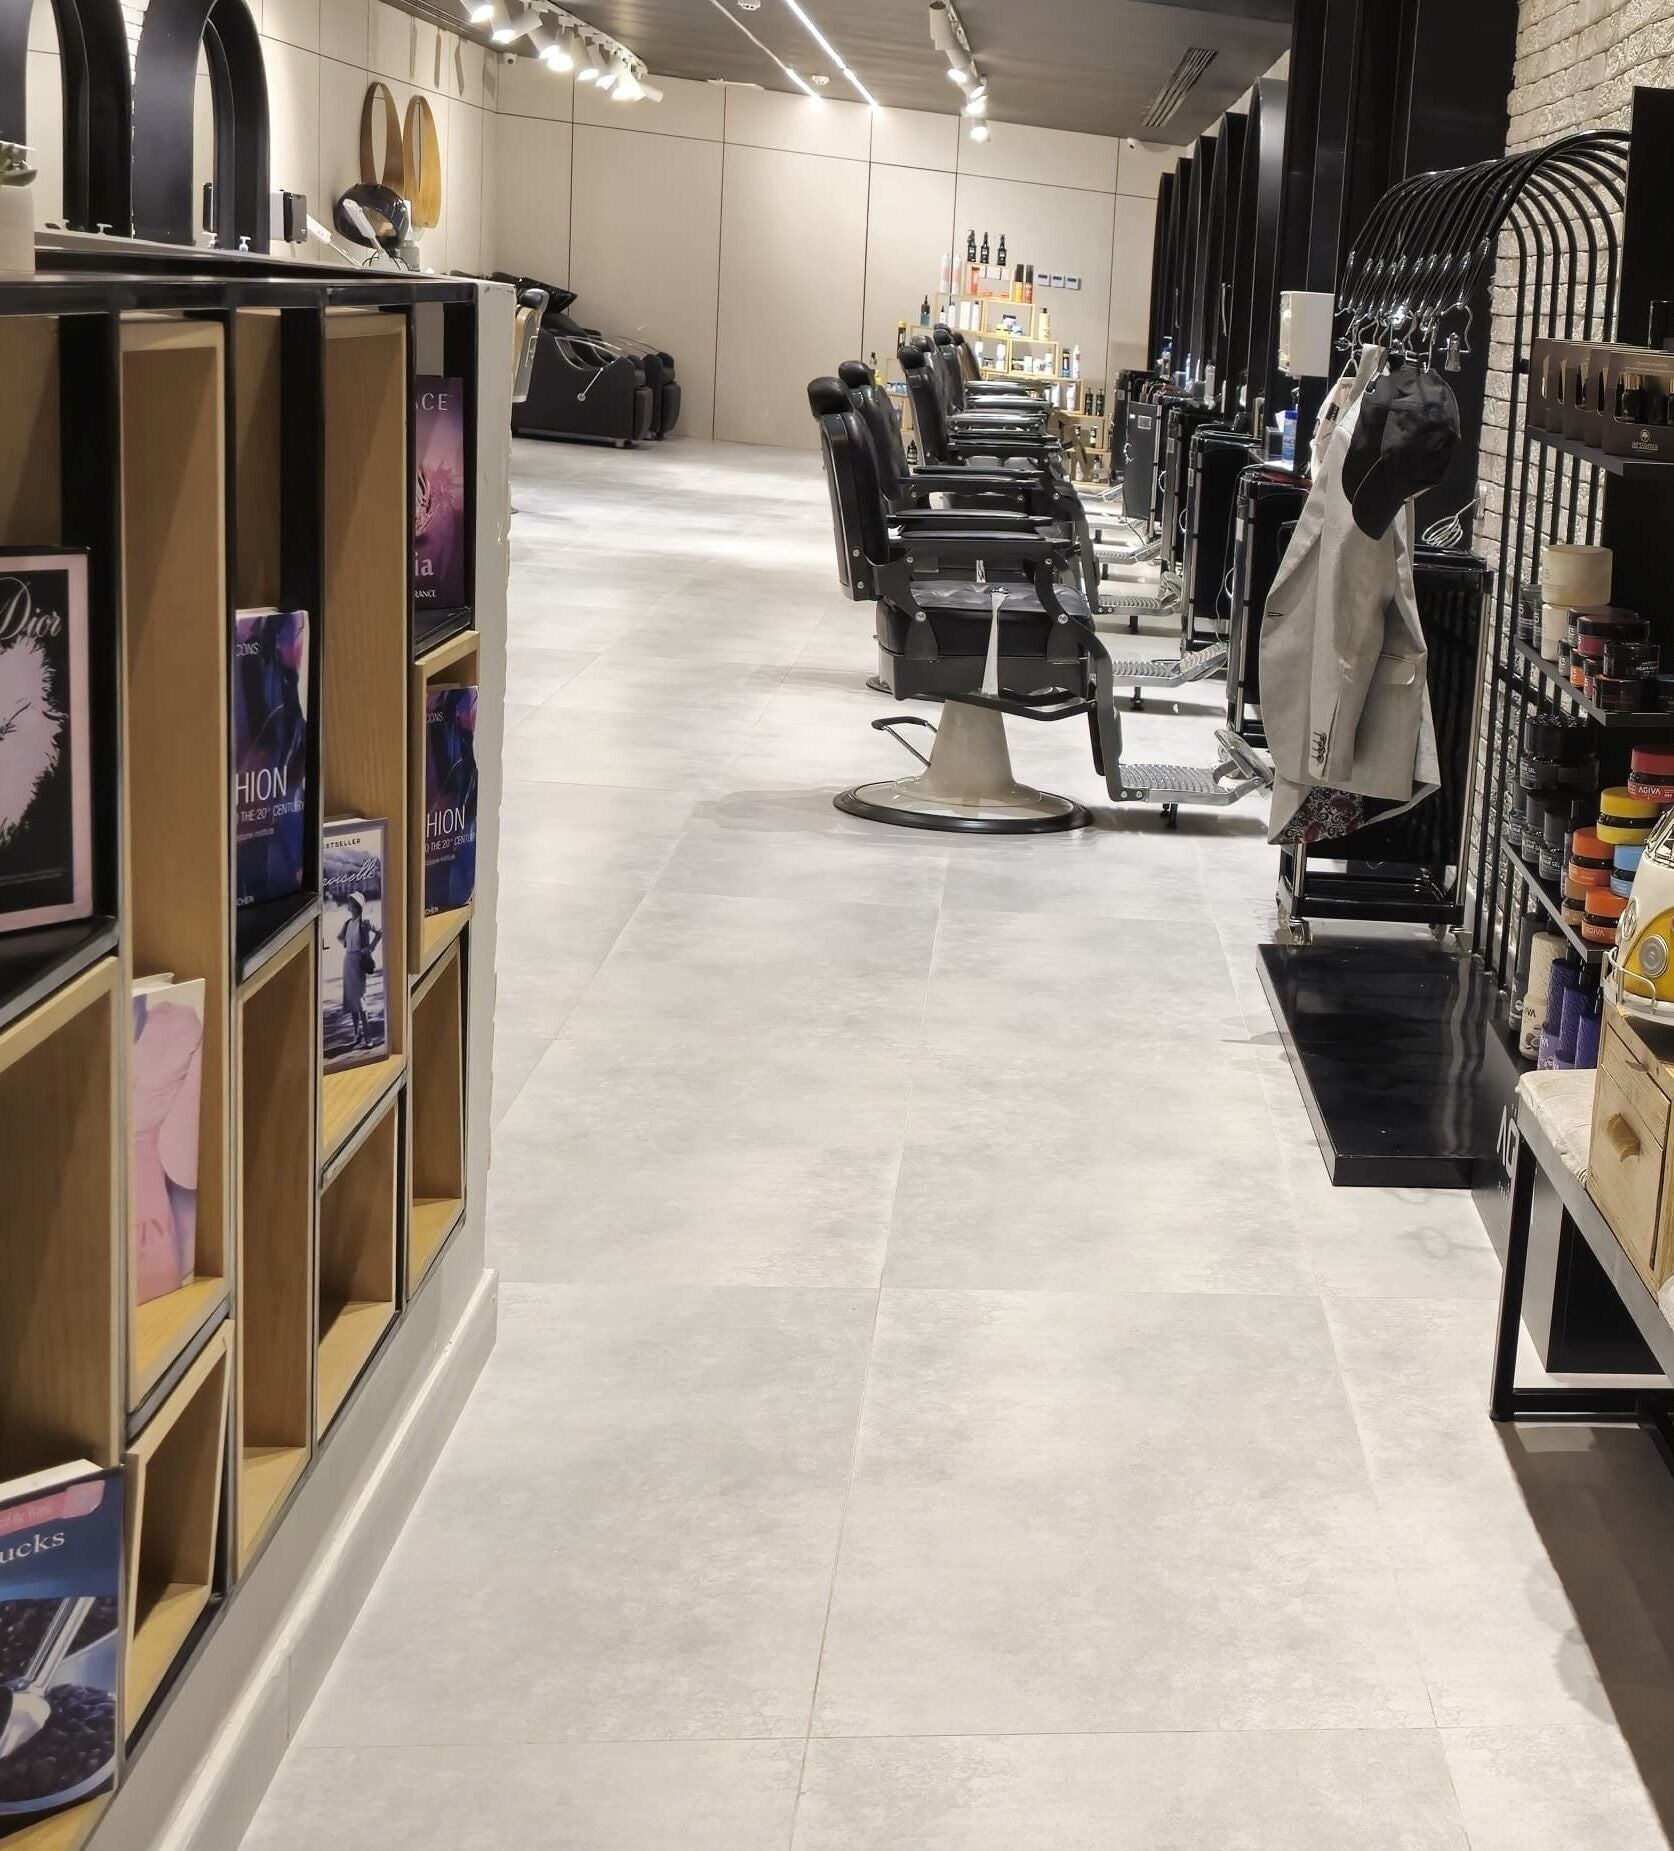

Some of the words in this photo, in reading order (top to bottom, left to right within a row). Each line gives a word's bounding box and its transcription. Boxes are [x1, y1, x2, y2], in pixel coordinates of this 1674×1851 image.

[235, 765, 287, 805] HION
[426, 804, 465, 838] HION
[0, 1532, 65, 1564] ucks
